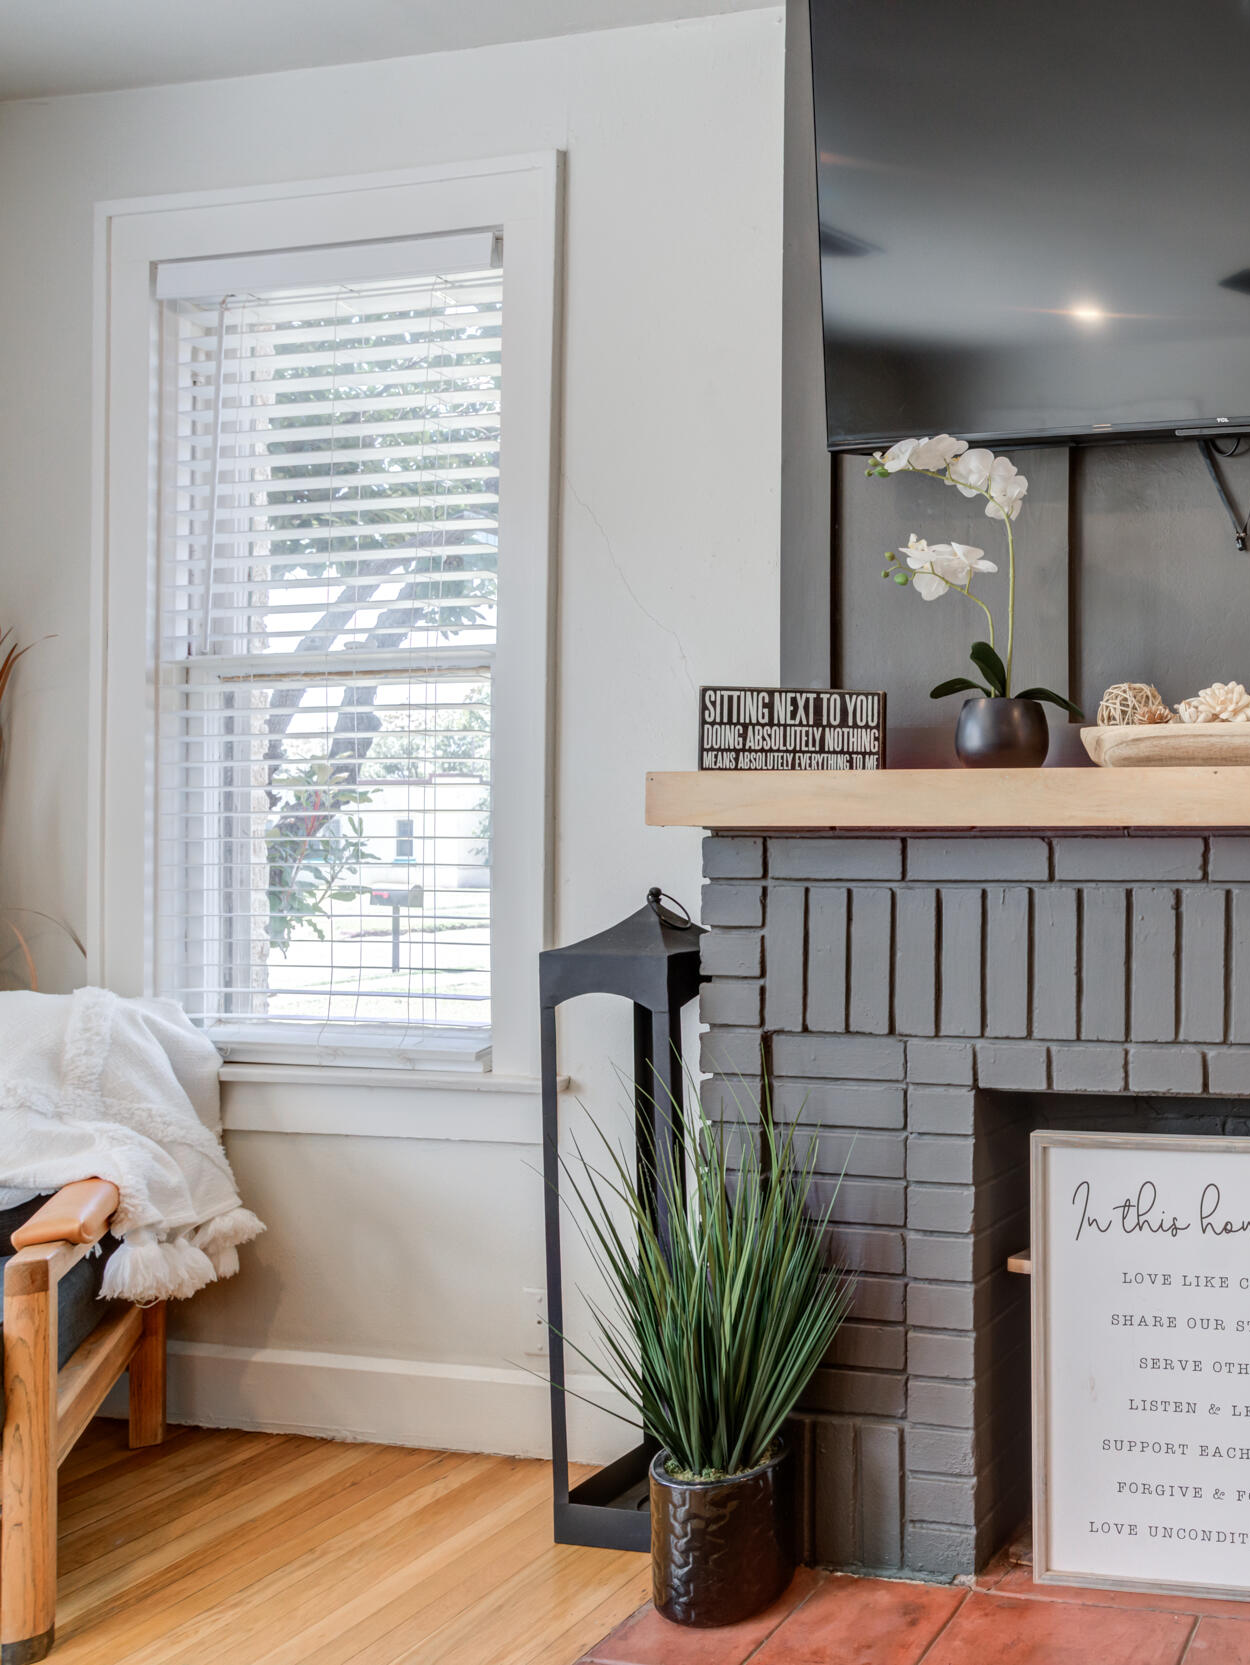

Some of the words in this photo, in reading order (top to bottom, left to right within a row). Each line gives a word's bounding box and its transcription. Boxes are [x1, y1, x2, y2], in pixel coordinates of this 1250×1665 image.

[705, 690, 769, 723] SITTING
[774, 692, 817, 725] NEXT
[820, 694, 841, 727] TO
[846, 695, 879, 727] YOU
[703, 724, 743, 749] DOING
[745, 726, 822, 751] ABSOLUTELY
[825, 728, 879, 752] NOTHING
[703, 751, 736, 769] MEANS
[737, 753, 793, 770] ABSOLUTELY
[796, 754, 850, 770] EVERYTHING
[852, 754, 863, 770] TO
[1071, 1180, 1113, 1242] In
[1112, 1180, 1191, 1238] this
[1121, 1271, 1172, 1286] LOVE
[1181, 1274, 1229, 1289] LIKE
[1111, 1313, 1177, 1329] SHARE
[1186, 1317, 1226, 1331] OUR
[1139, 1357, 1203, 1373] SERVE
[1128, 1398, 1198, 1415] LISTEN
[1207, 1403, 1221, 1416] &
[1101, 1438, 1189, 1456] SUPPORT
[1116, 1479, 1203, 1499] FORGIVE
[1212, 1487, 1226, 1501] &
[1088, 1521, 1138, 1536] LOVE
